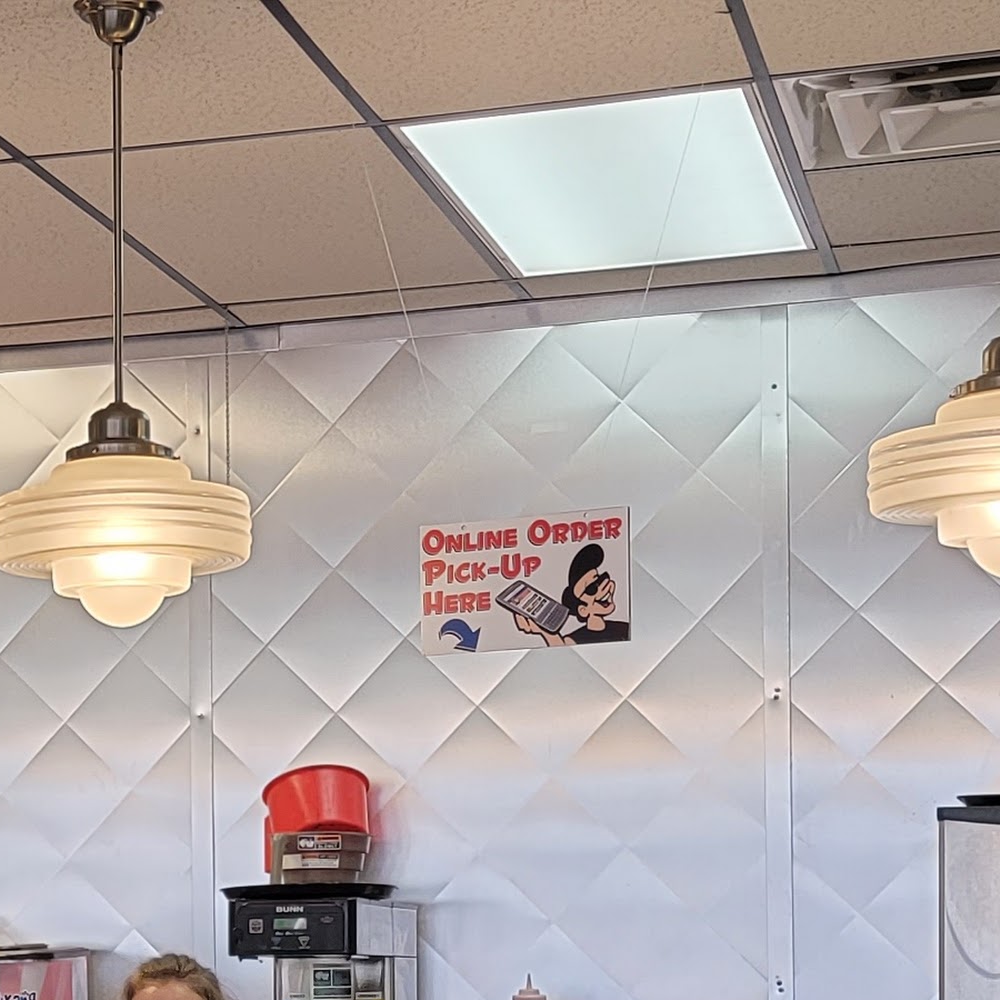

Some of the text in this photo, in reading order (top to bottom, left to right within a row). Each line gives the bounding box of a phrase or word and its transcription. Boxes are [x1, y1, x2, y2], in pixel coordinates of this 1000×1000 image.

[422, 517, 622, 555] ONLINE ORDER
[422, 553, 542, 586] PICK-UP
[423, 591, 491, 616] HERE
